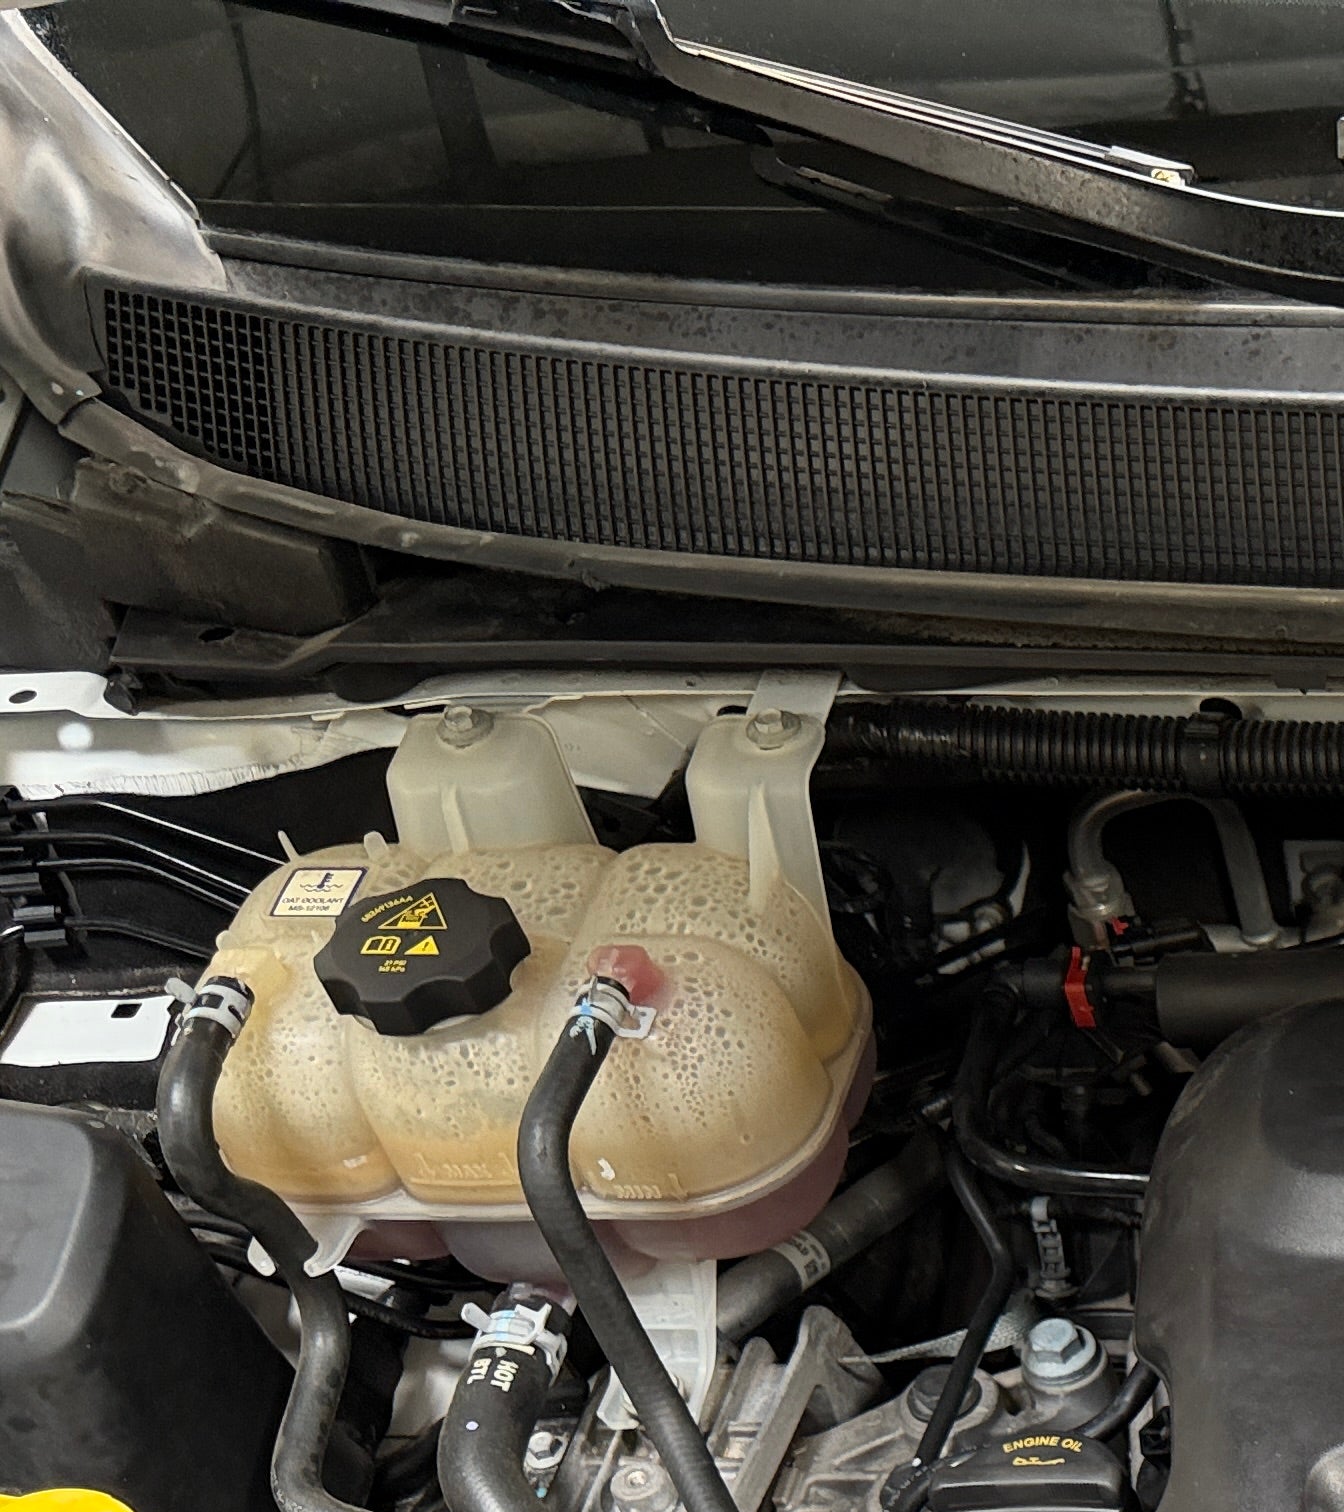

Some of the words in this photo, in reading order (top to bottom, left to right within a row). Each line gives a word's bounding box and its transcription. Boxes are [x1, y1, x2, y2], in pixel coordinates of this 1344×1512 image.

[490, 1360, 519, 1392] HOT
[1002, 1435, 1060, 1453] ENGINE
[1061, 1437, 1083, 1453] OIL
